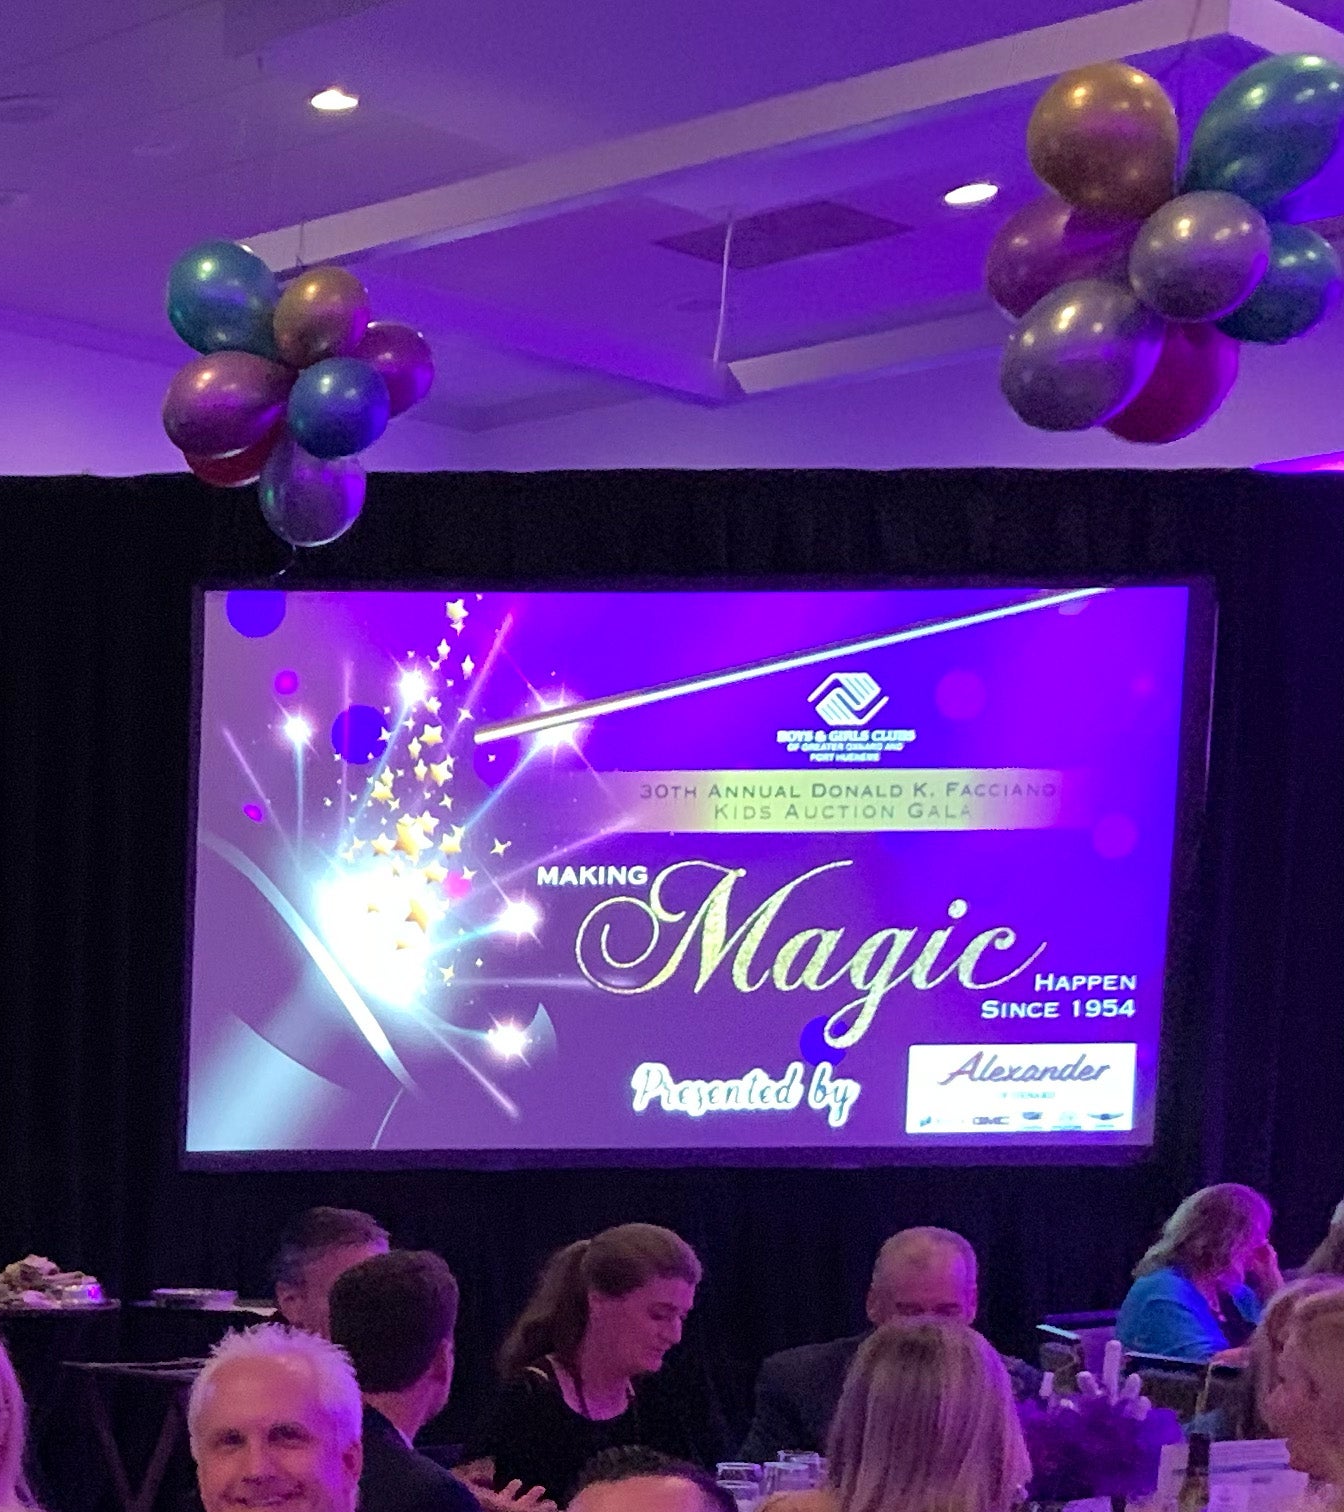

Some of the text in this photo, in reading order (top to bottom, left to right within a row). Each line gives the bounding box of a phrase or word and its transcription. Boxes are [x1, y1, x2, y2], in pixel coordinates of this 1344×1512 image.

[777, 729, 916, 742] BOYS & GIRLS CLUBS
[640, 781, 1056, 800] 30TH ANNUAL DONALD K. FACCIANO
[715, 803, 972, 820] KIDS AUCTION GALA
[537, 865, 649, 886] MAKING
[575, 859, 1048, 1049] Magic
[1035, 973, 1137, 993] HAPPEN
[980, 1000, 1137, 1019] SINCE 1954
[937, 1051, 1110, 1086] Alexander
[632, 1062, 861, 1126] Presented by
